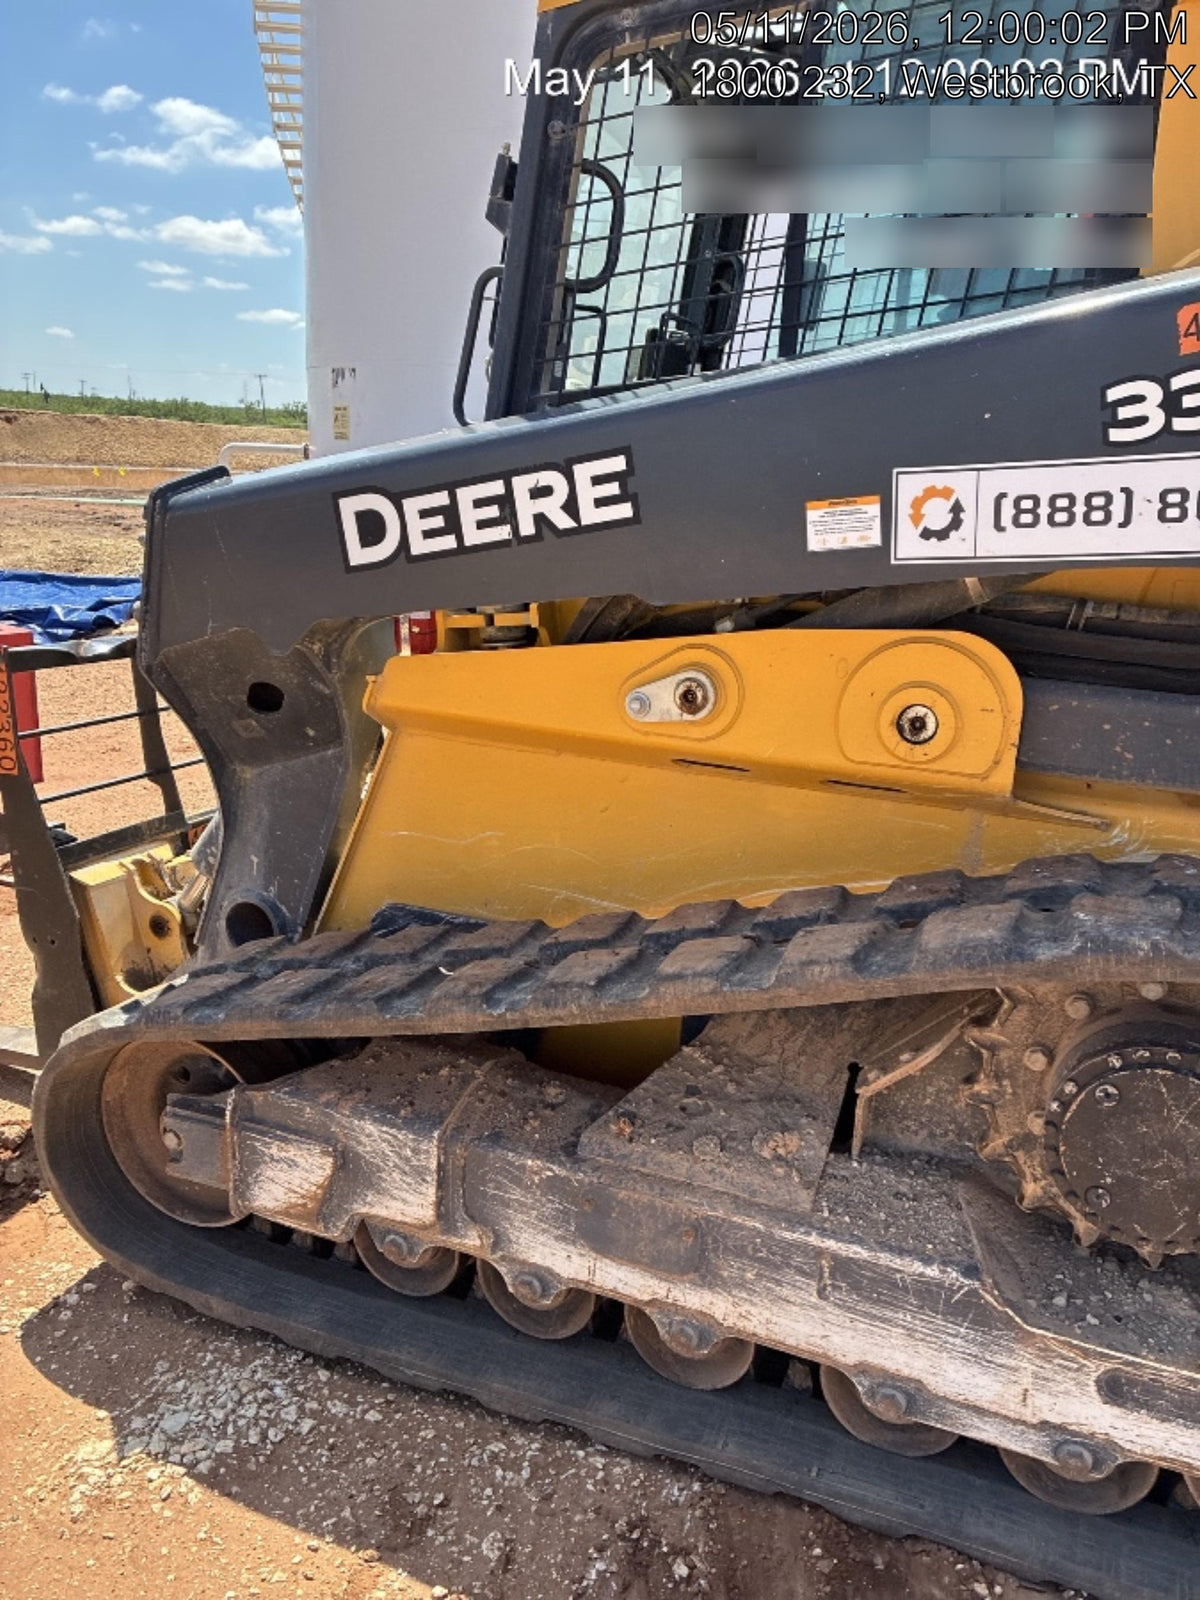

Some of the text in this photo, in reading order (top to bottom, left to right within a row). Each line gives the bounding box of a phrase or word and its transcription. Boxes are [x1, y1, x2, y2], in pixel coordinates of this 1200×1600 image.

[338, 454, 634, 566] DEERE
[993, 487, 1200, 533] (888) 8
